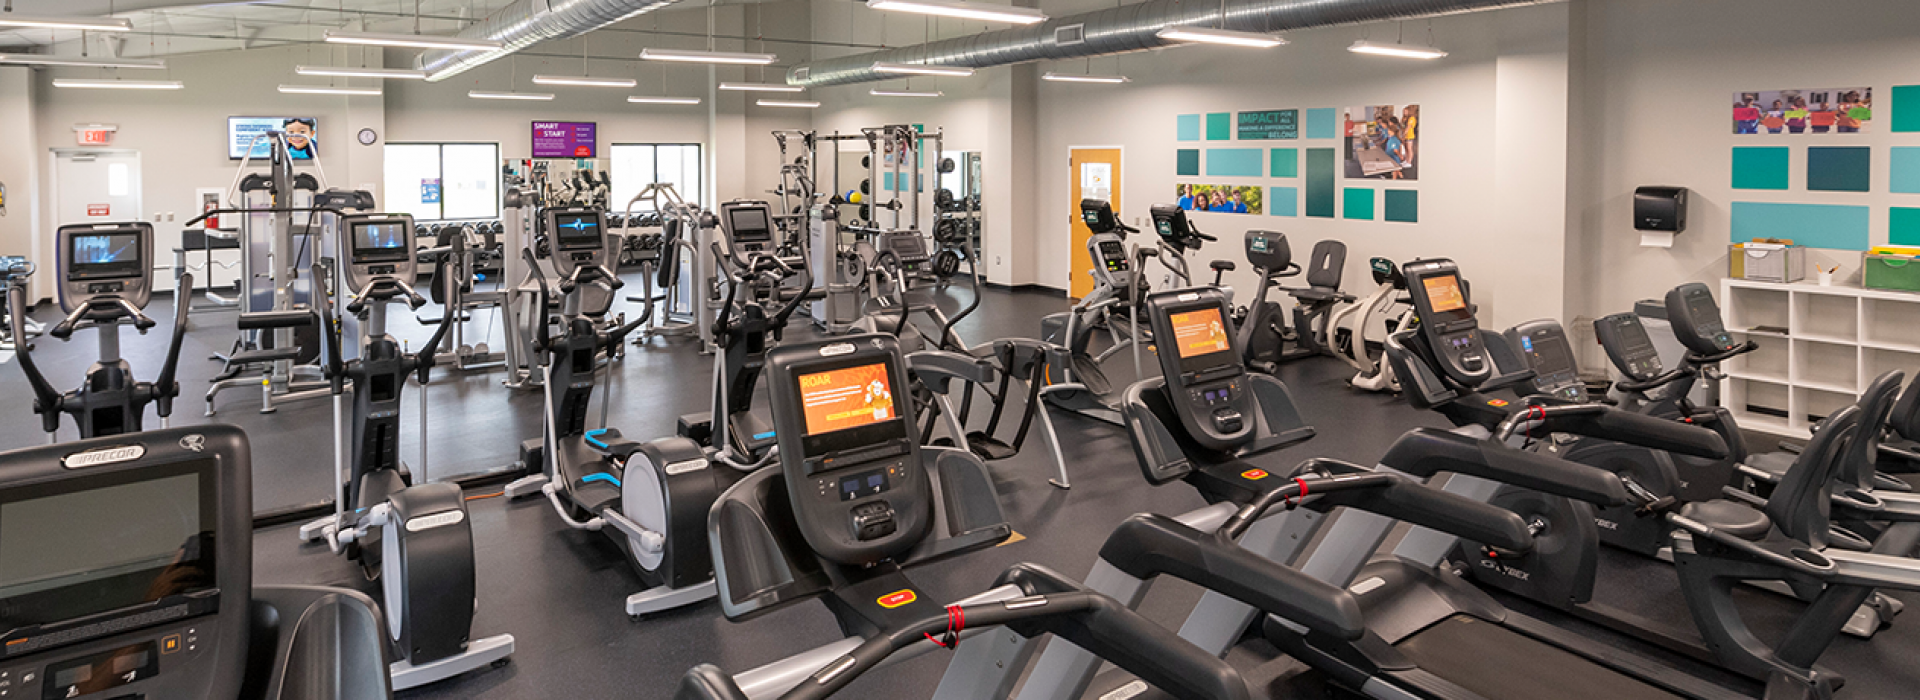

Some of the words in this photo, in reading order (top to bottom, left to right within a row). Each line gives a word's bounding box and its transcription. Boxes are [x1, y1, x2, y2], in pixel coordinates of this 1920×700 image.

[1238, 112, 1279, 123] IMPACT
[544, 130, 565, 138] START
[802, 374, 831, 388] ROAR
[82, 448, 136, 463] PRECOR
